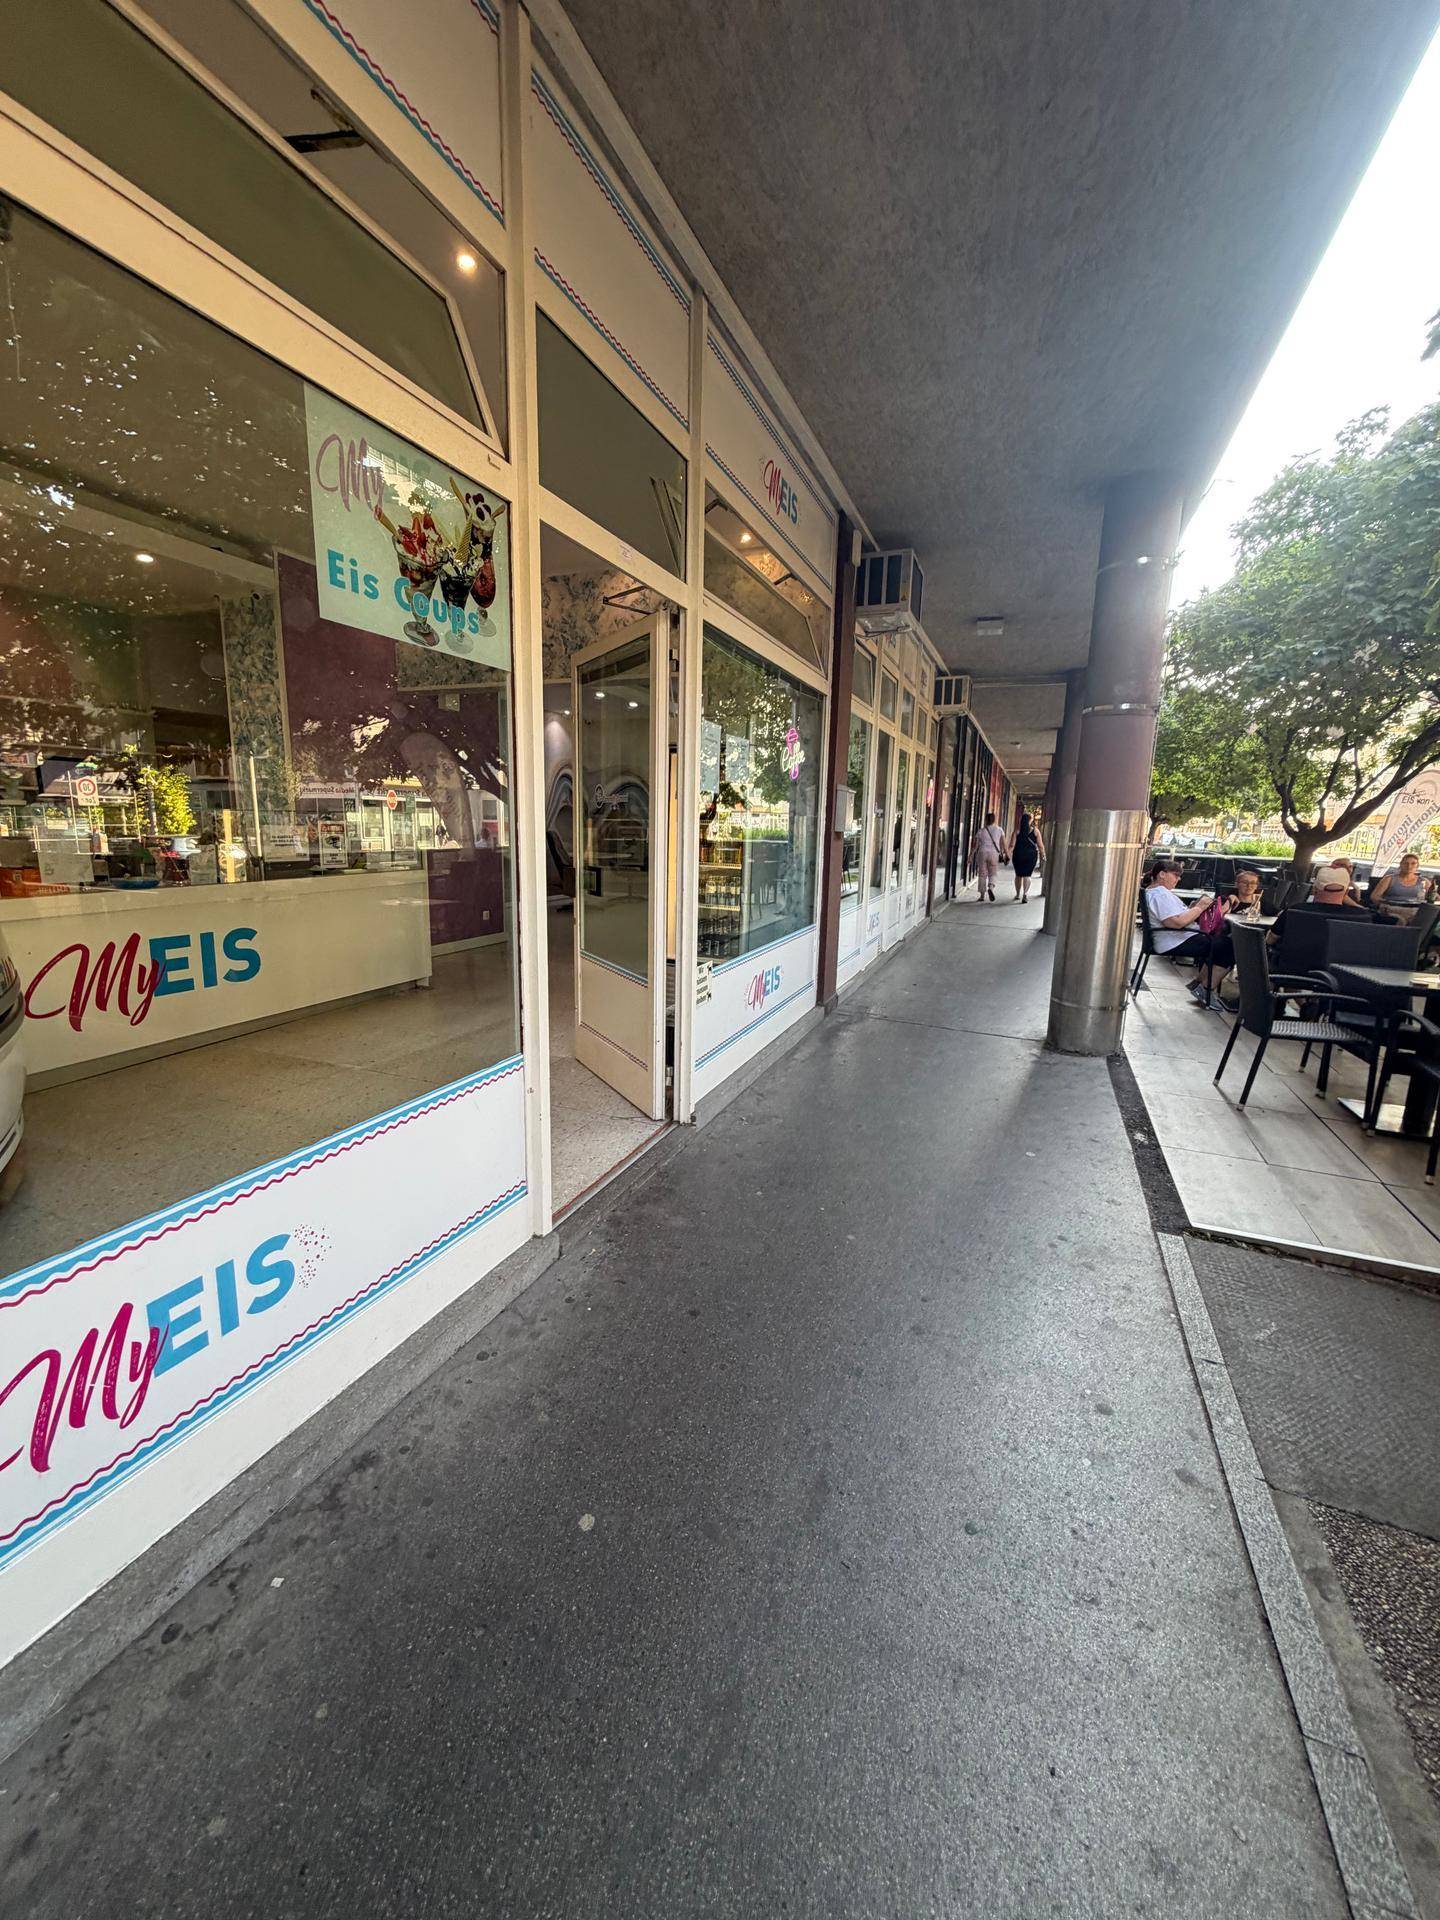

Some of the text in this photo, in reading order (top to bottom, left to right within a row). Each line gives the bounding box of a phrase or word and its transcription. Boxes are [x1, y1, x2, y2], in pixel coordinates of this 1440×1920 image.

[327, 549, 480, 635] Eis Coups
[1382, 814, 1412, 854] Zanoni
